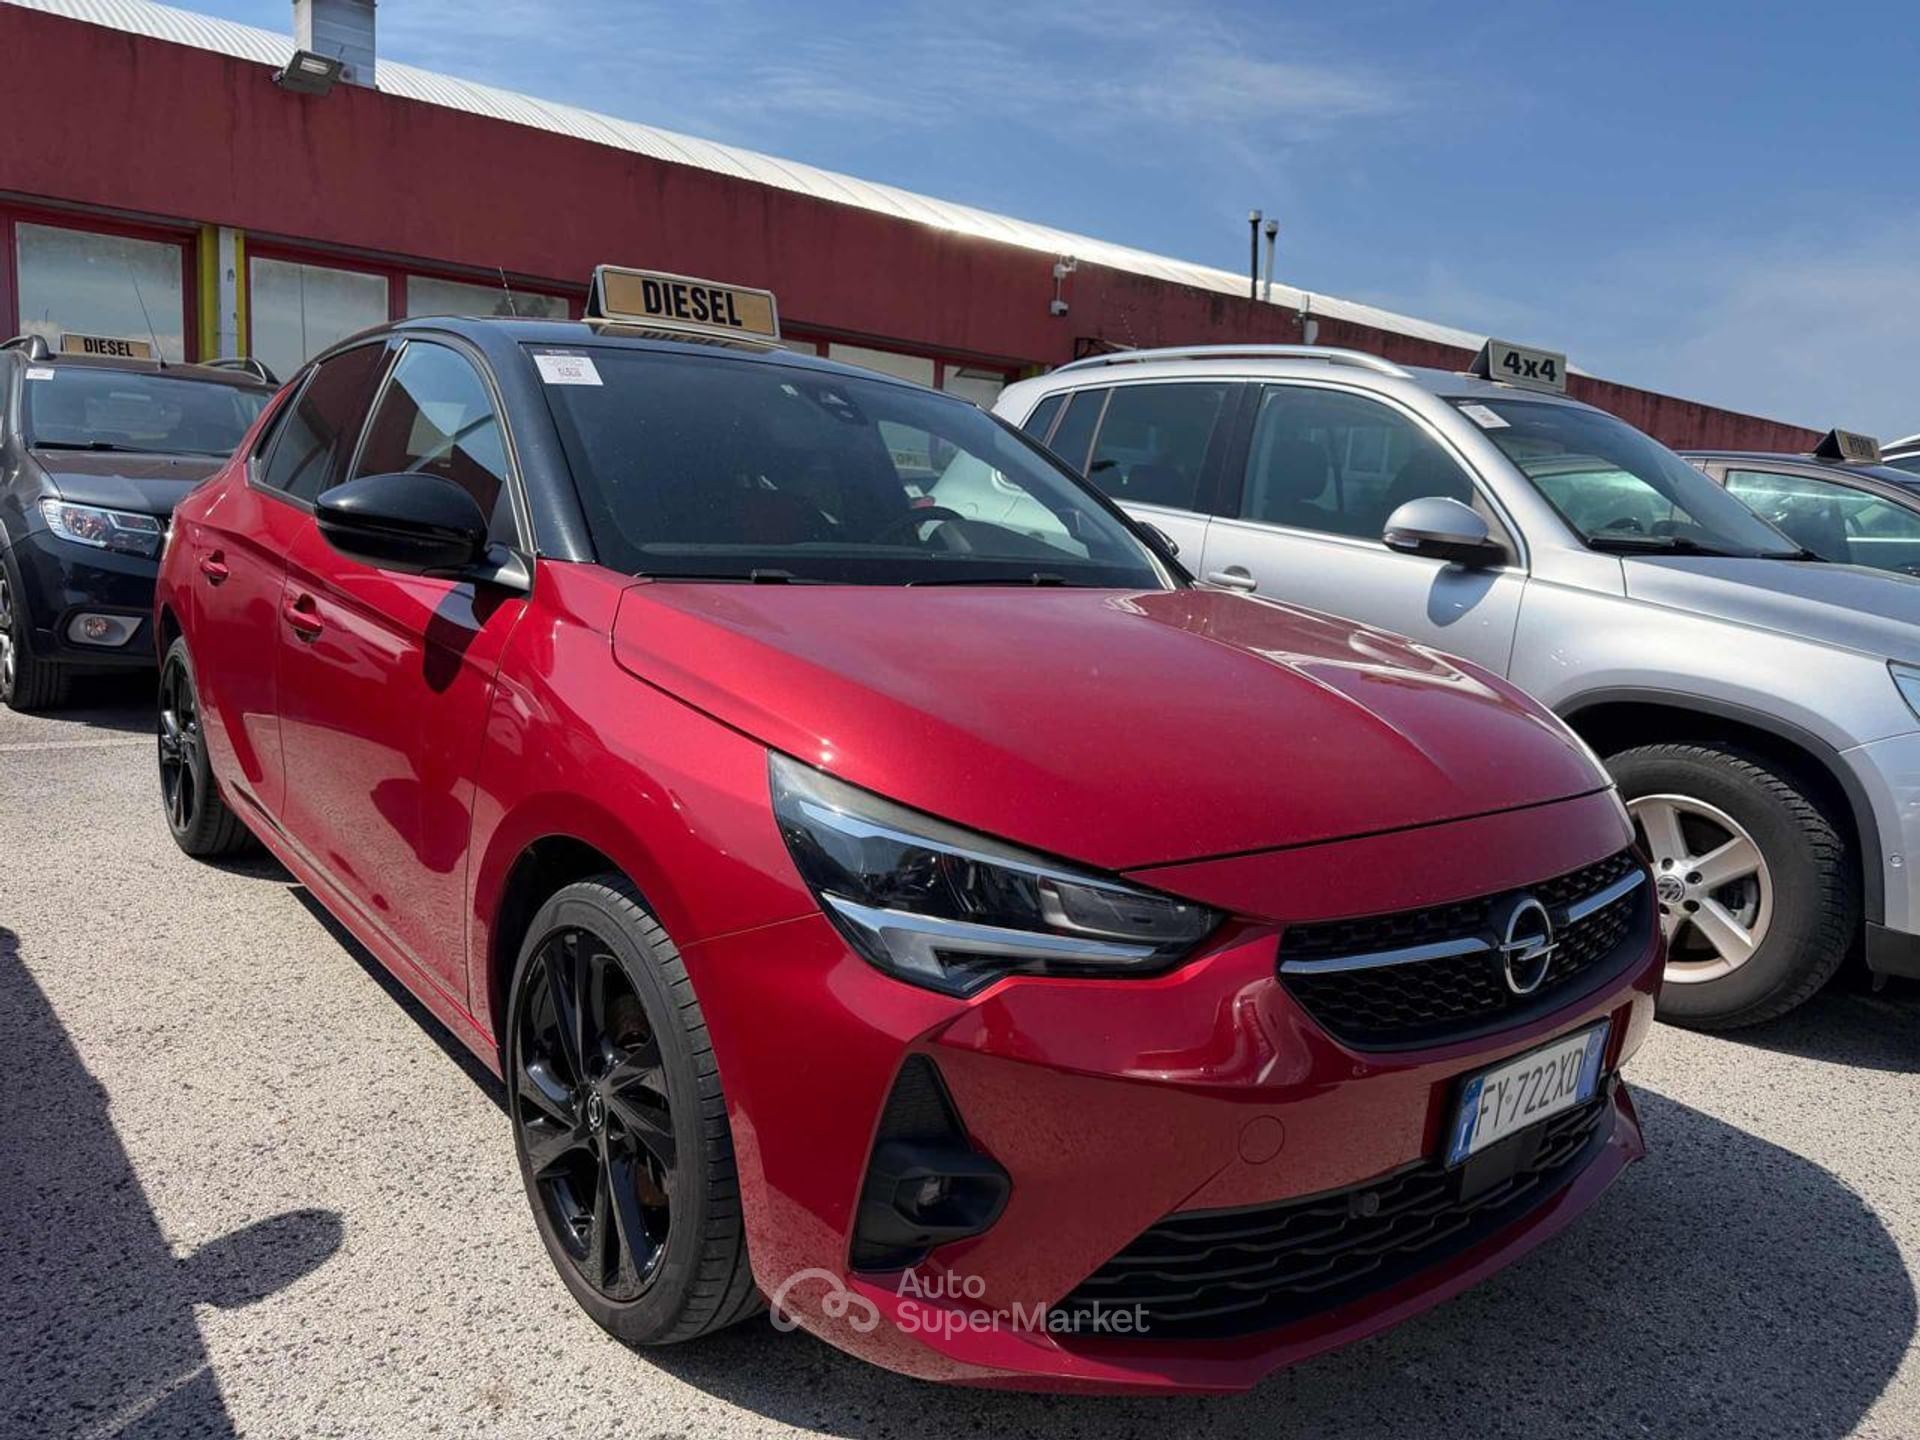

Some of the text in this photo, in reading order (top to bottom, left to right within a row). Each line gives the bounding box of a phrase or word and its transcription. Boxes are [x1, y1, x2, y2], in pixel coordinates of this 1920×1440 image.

[642, 279, 743, 327] DIESEL
[84, 337, 134, 357] DIESEL
[1503, 351, 1557, 382] 4x4
